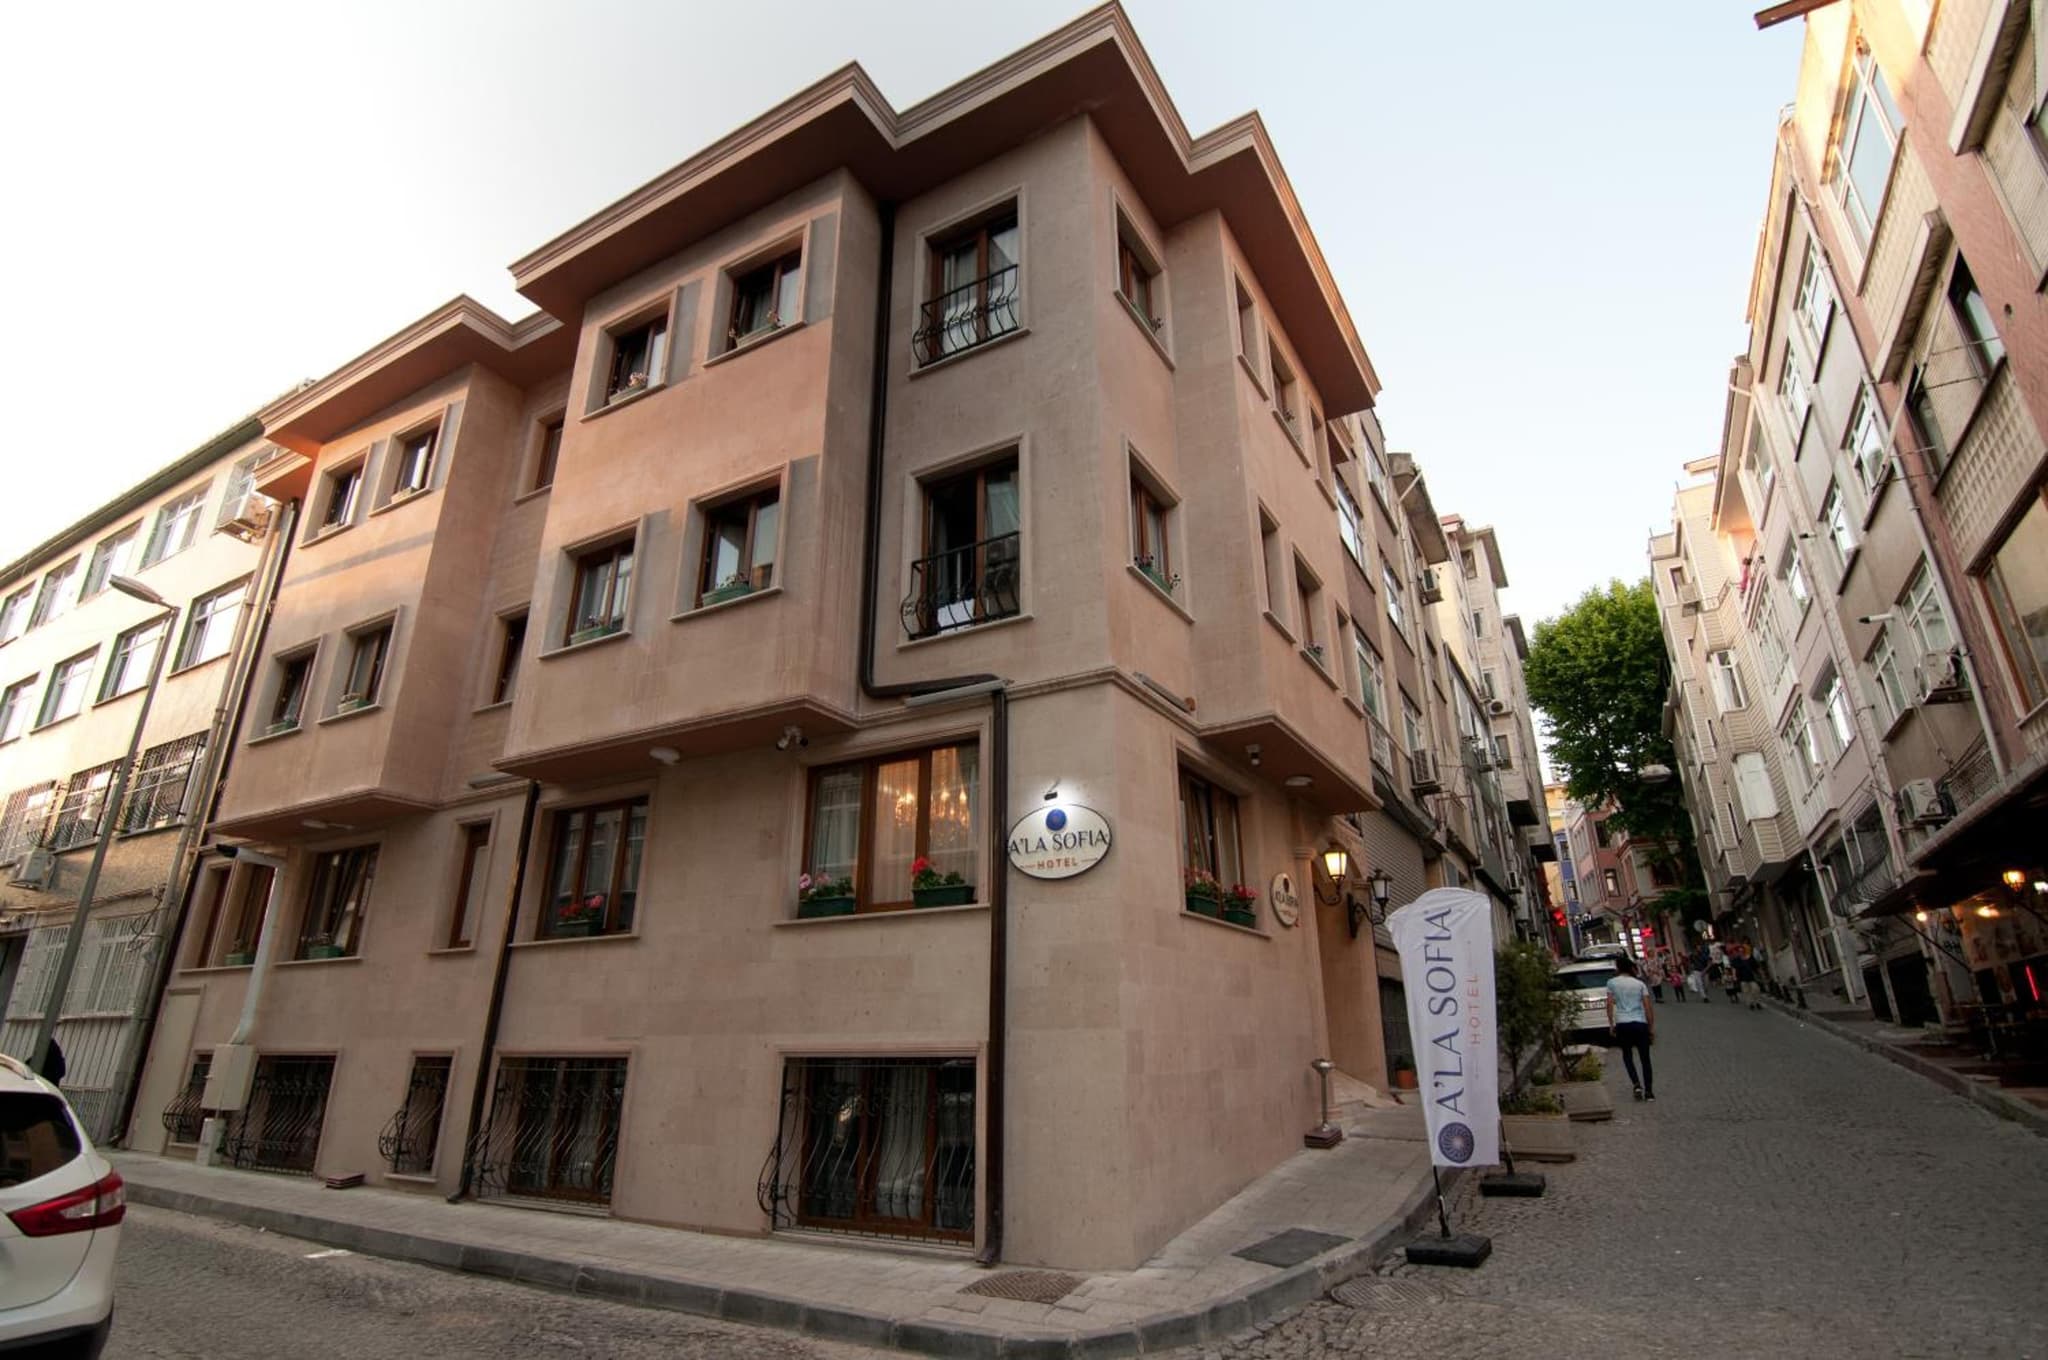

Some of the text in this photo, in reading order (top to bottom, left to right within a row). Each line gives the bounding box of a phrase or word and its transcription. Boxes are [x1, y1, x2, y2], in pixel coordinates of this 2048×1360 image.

[1008, 829, 1108, 855] A'LA SOFIA
[1037, 857, 1078, 870] HOTEL
[1424, 908, 1465, 1117] A'LA SOFIA
[1466, 974, 1481, 1045] HOTEL
